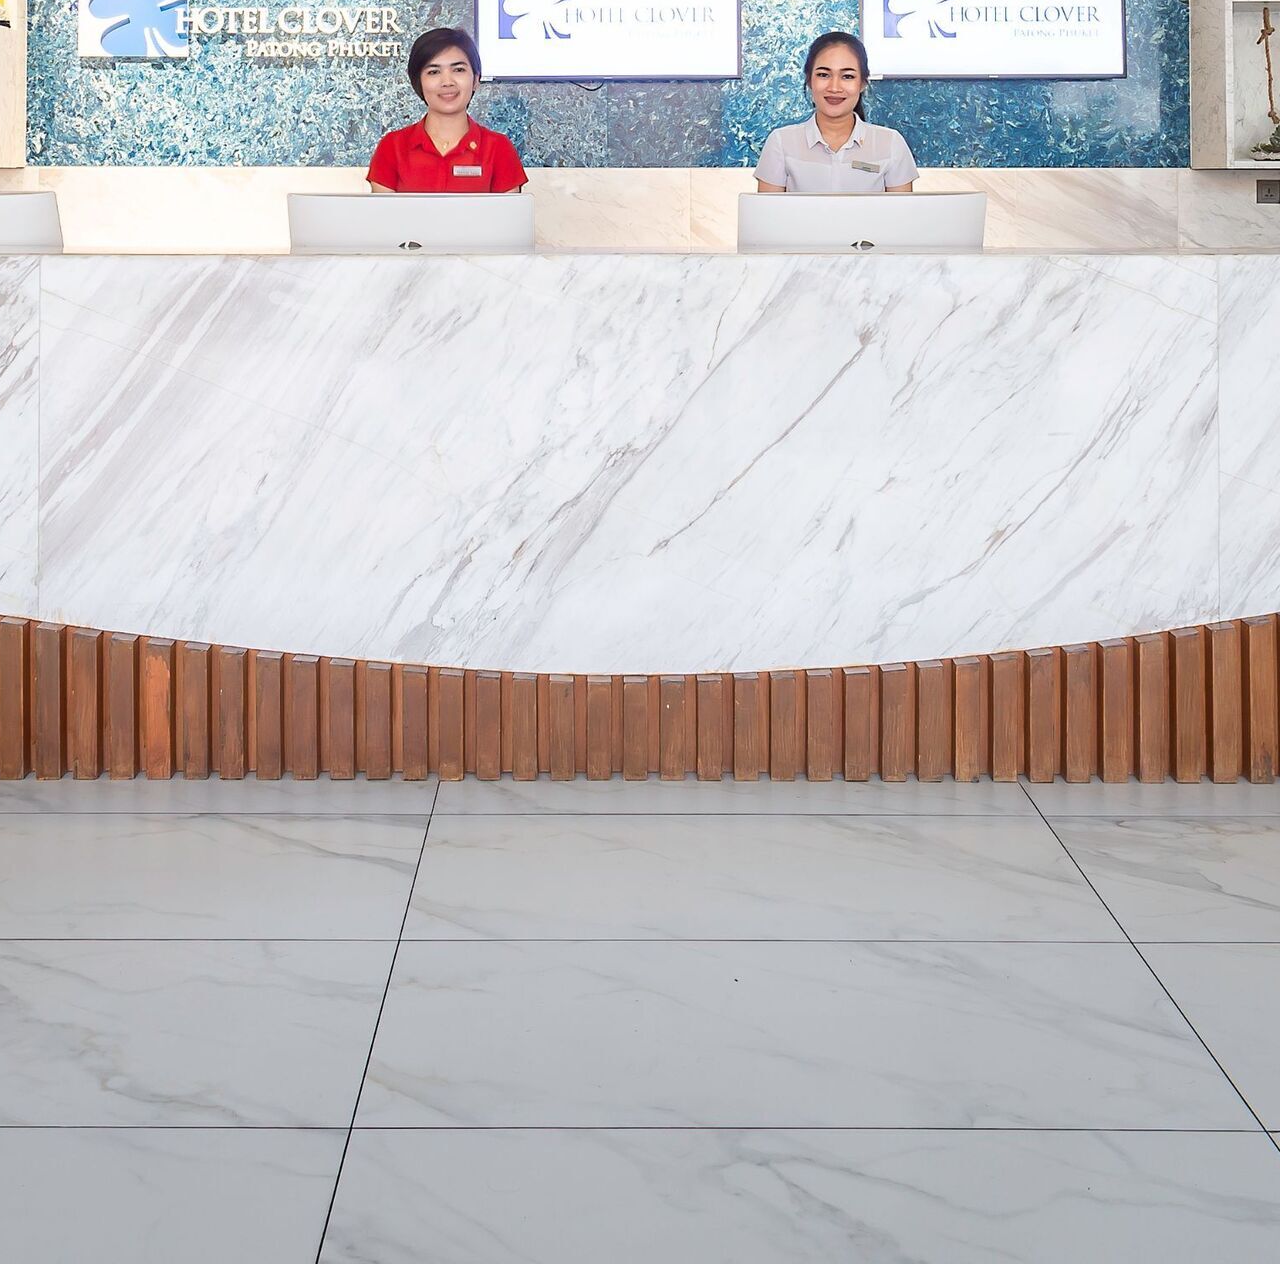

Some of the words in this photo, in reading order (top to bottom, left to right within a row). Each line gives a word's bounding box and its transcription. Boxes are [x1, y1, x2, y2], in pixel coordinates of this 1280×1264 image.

[174, 7, 275, 34] HOTEL
[278, 7, 404, 34] CLOVER
[949, 6, 1013, 23] HOTEL
[1019, 6, 1101, 23] CLOVER
[246, 40, 321, 57] PATONG
[327, 40, 402, 57] PHUKET
